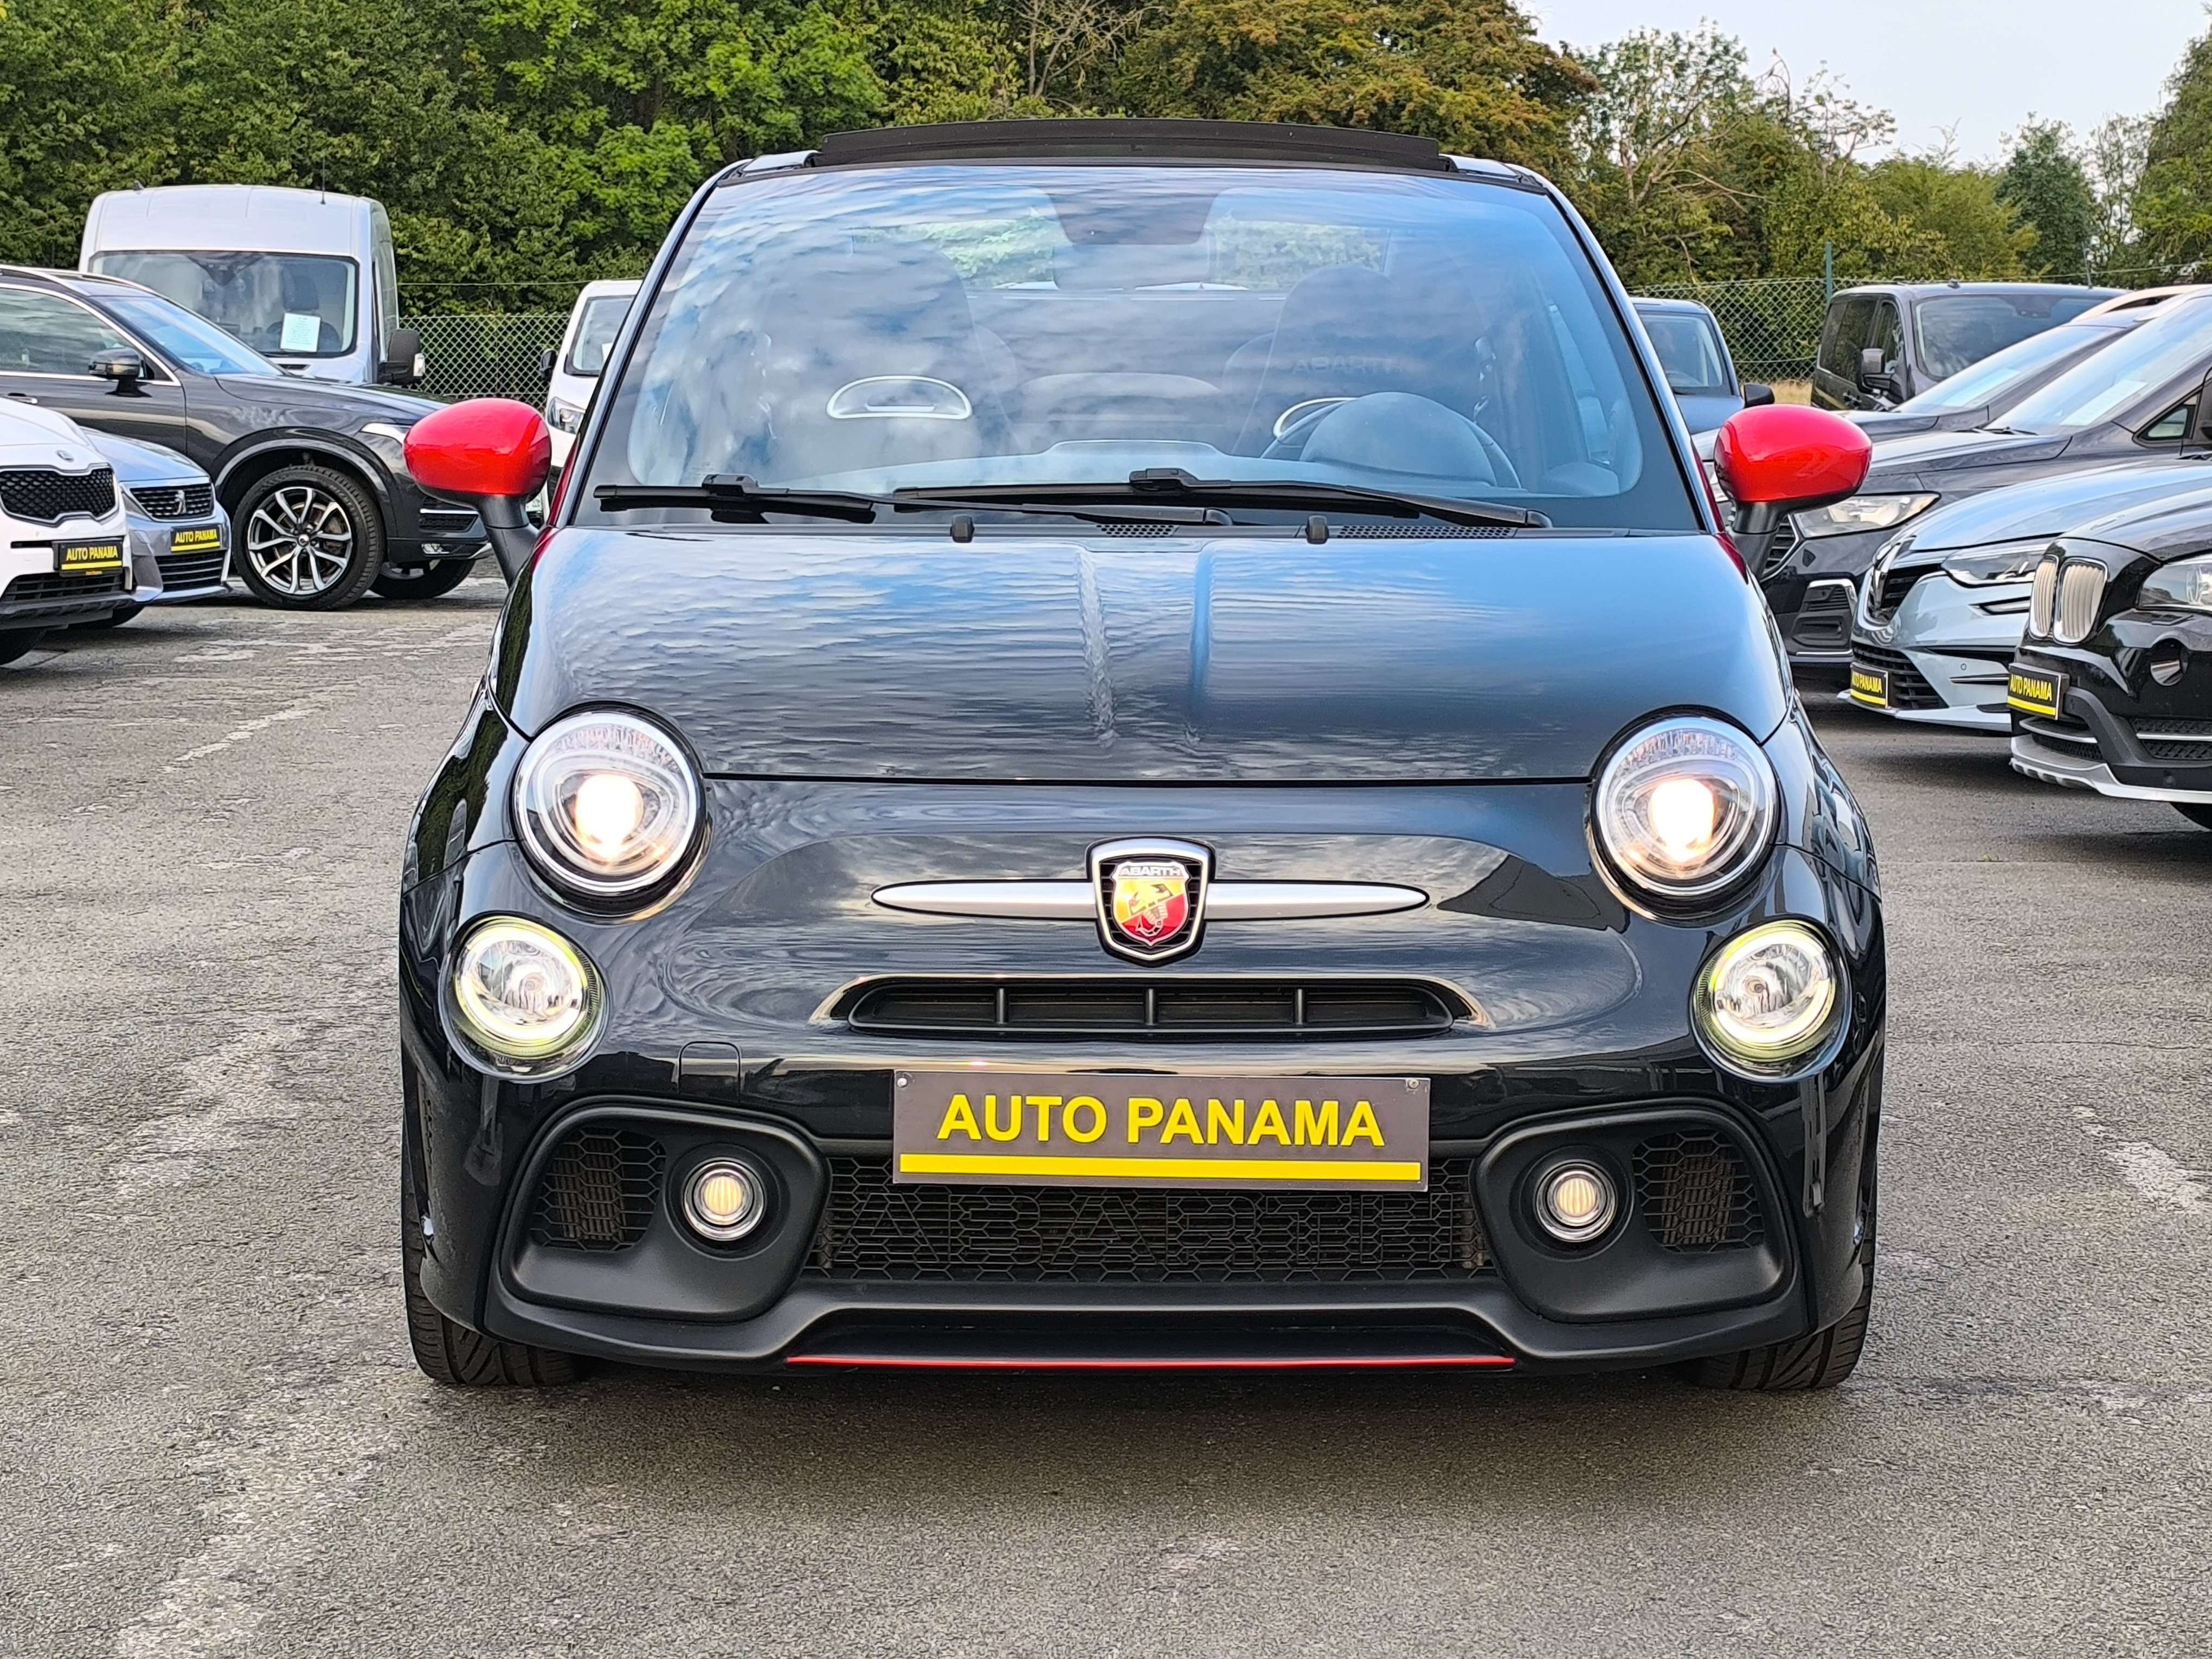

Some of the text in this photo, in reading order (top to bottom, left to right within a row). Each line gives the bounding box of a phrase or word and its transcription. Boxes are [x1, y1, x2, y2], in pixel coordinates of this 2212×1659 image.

[175, 529, 217, 544] AUTO PANAMA
[66, 545, 118, 561] AUTO PANAMA
[1860, 673, 1883, 694] PANAMA
[2010, 673, 2052, 702] AUTO PANAMA
[1118, 866, 1183, 876] ABARTH
[936, 1094, 1386, 1148] AUTO PANAMA
[834, 1192, 1455, 1266] ABARTH
